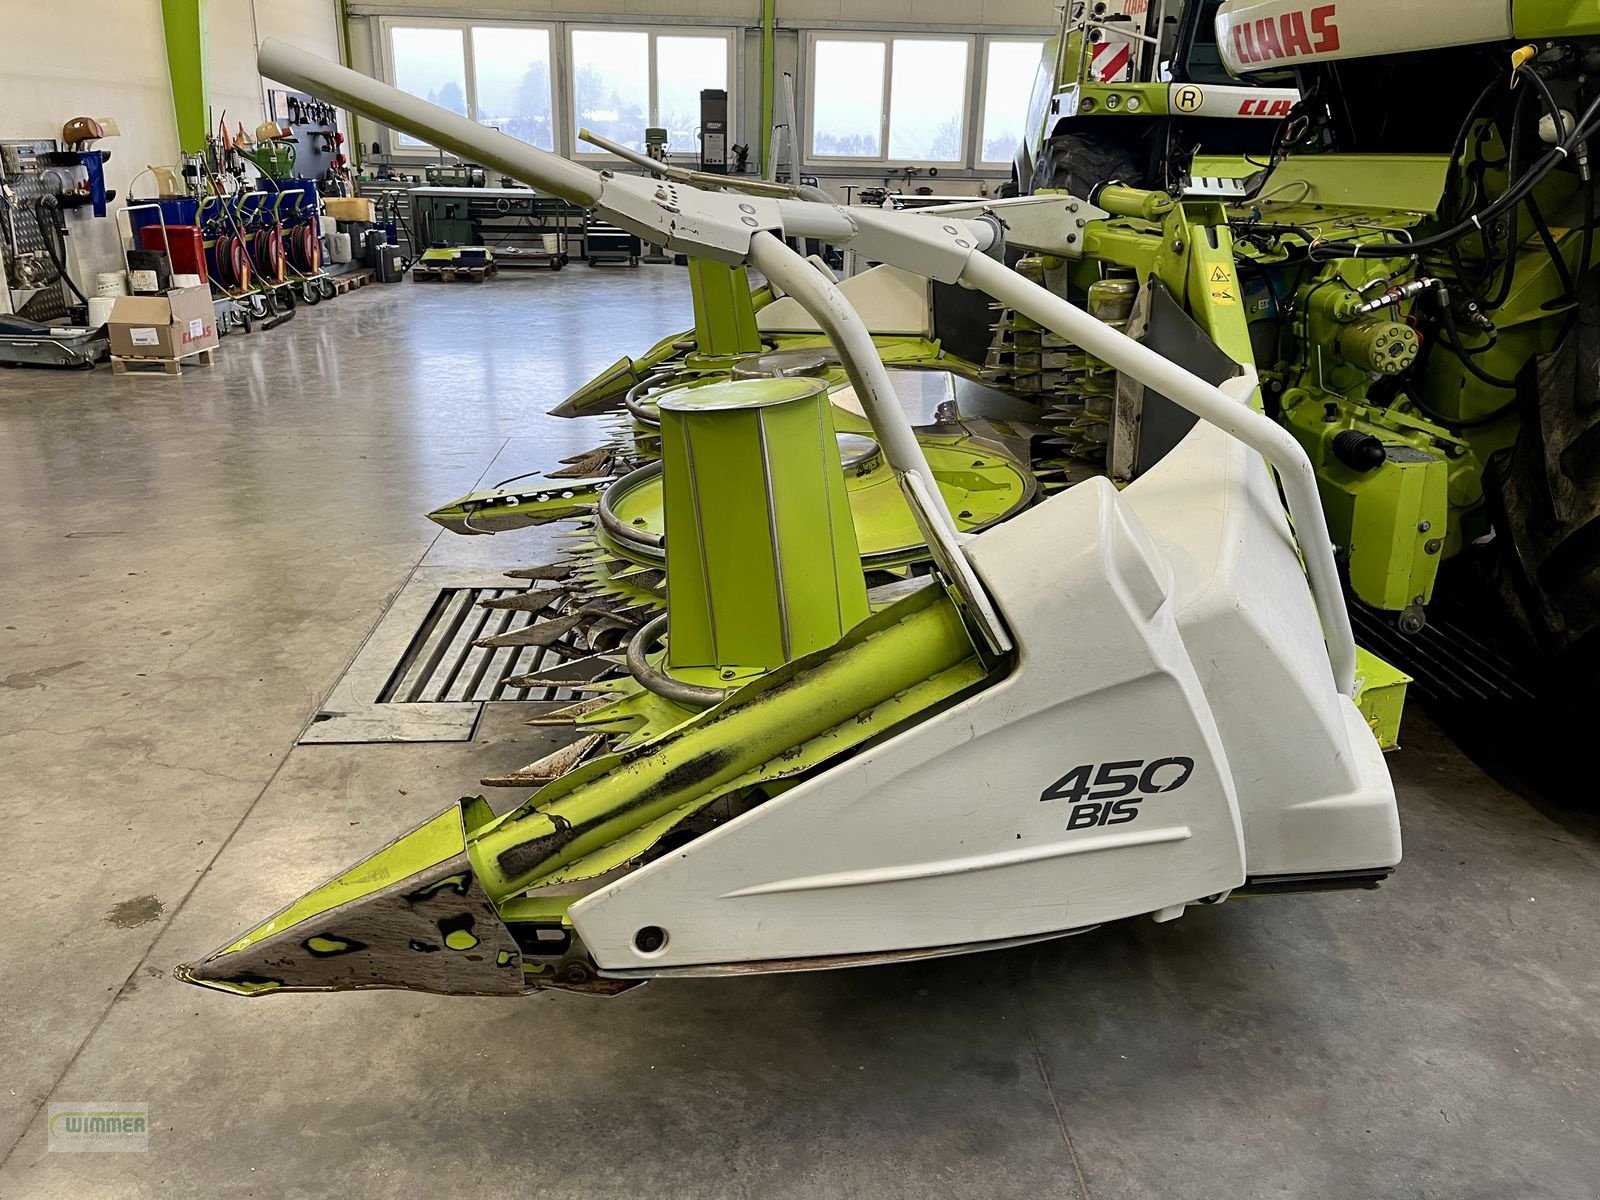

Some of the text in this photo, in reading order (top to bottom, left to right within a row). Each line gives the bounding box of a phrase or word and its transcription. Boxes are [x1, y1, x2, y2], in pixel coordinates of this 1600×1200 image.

[1123, 0, 1147, 15] CLAAS
[1233, 4, 1340, 64] CLAAS
[1182, 90, 1196, 107] R
[182, 325, 212, 345] CLS
[1039, 756, 1195, 803] 450
[1066, 797, 1144, 830] BIS
